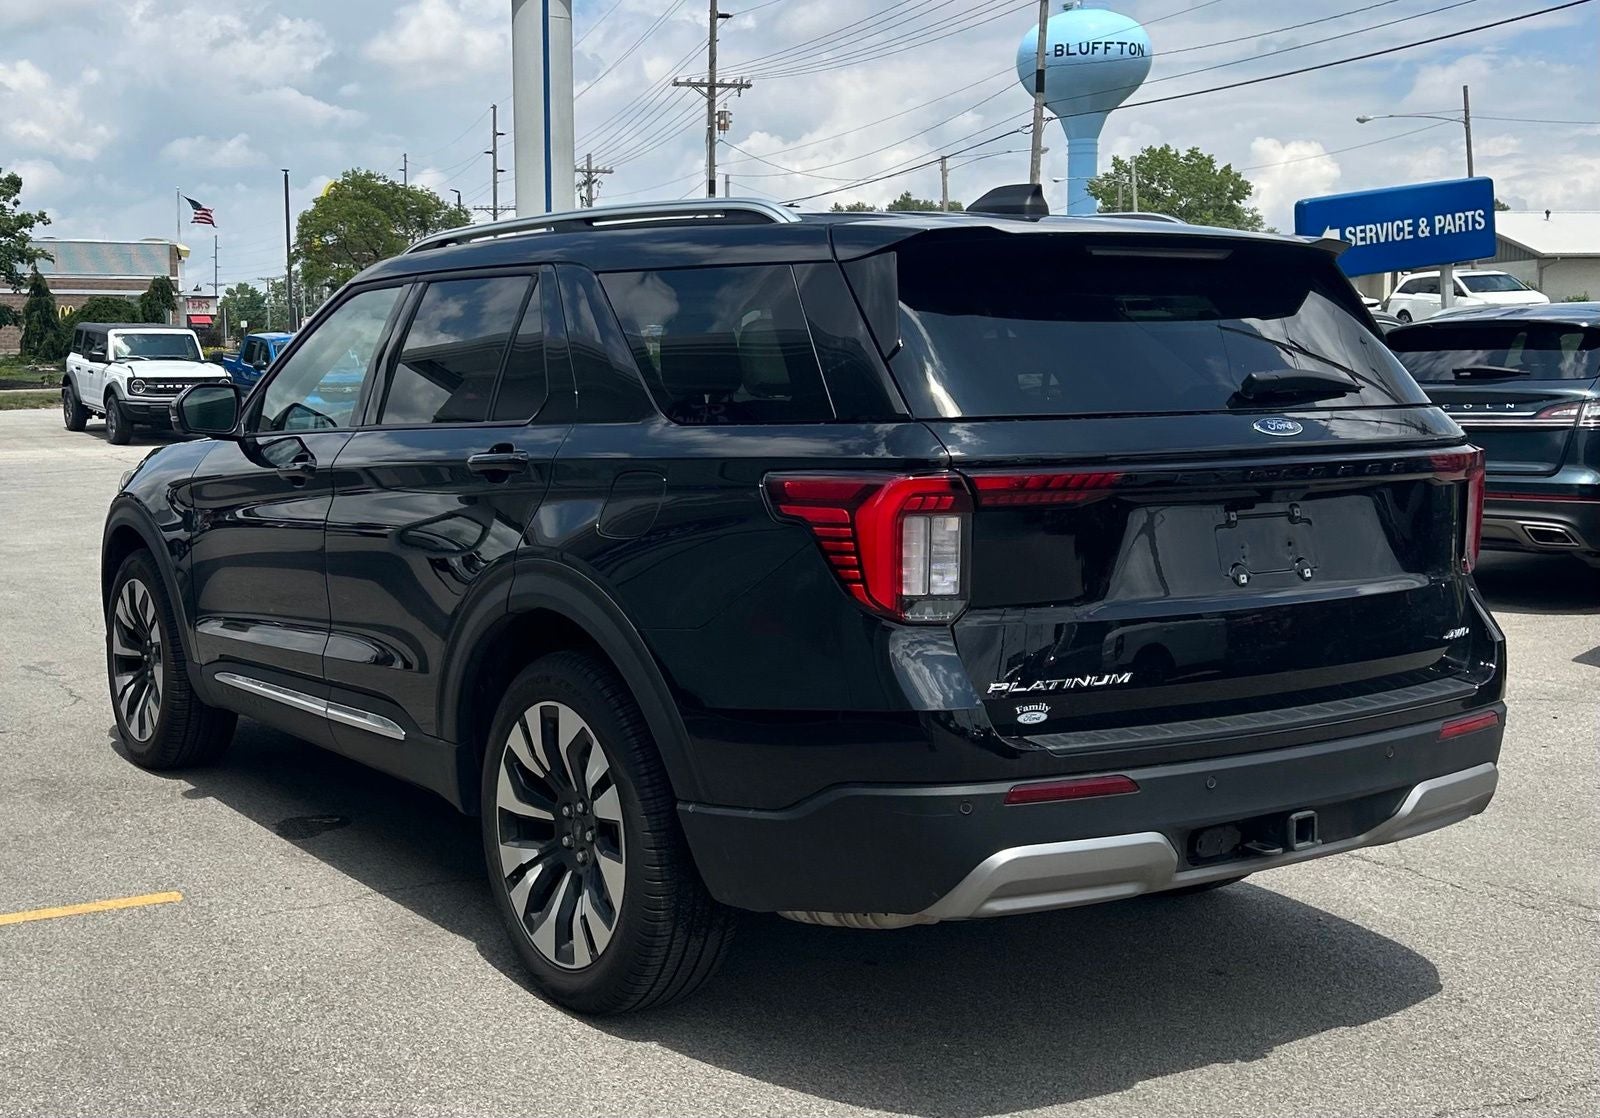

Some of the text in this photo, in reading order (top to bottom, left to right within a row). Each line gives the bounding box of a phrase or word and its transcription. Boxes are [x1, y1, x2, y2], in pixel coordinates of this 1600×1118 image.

[1054, 41, 1145, 57] BLUFFTON
[1345, 209, 1486, 247] SERVICE & PARTS
[1266, 419, 1294, 430] Ford
[986, 672, 1133, 694] PLATINUM
[1015, 702, 1051, 714] Family
